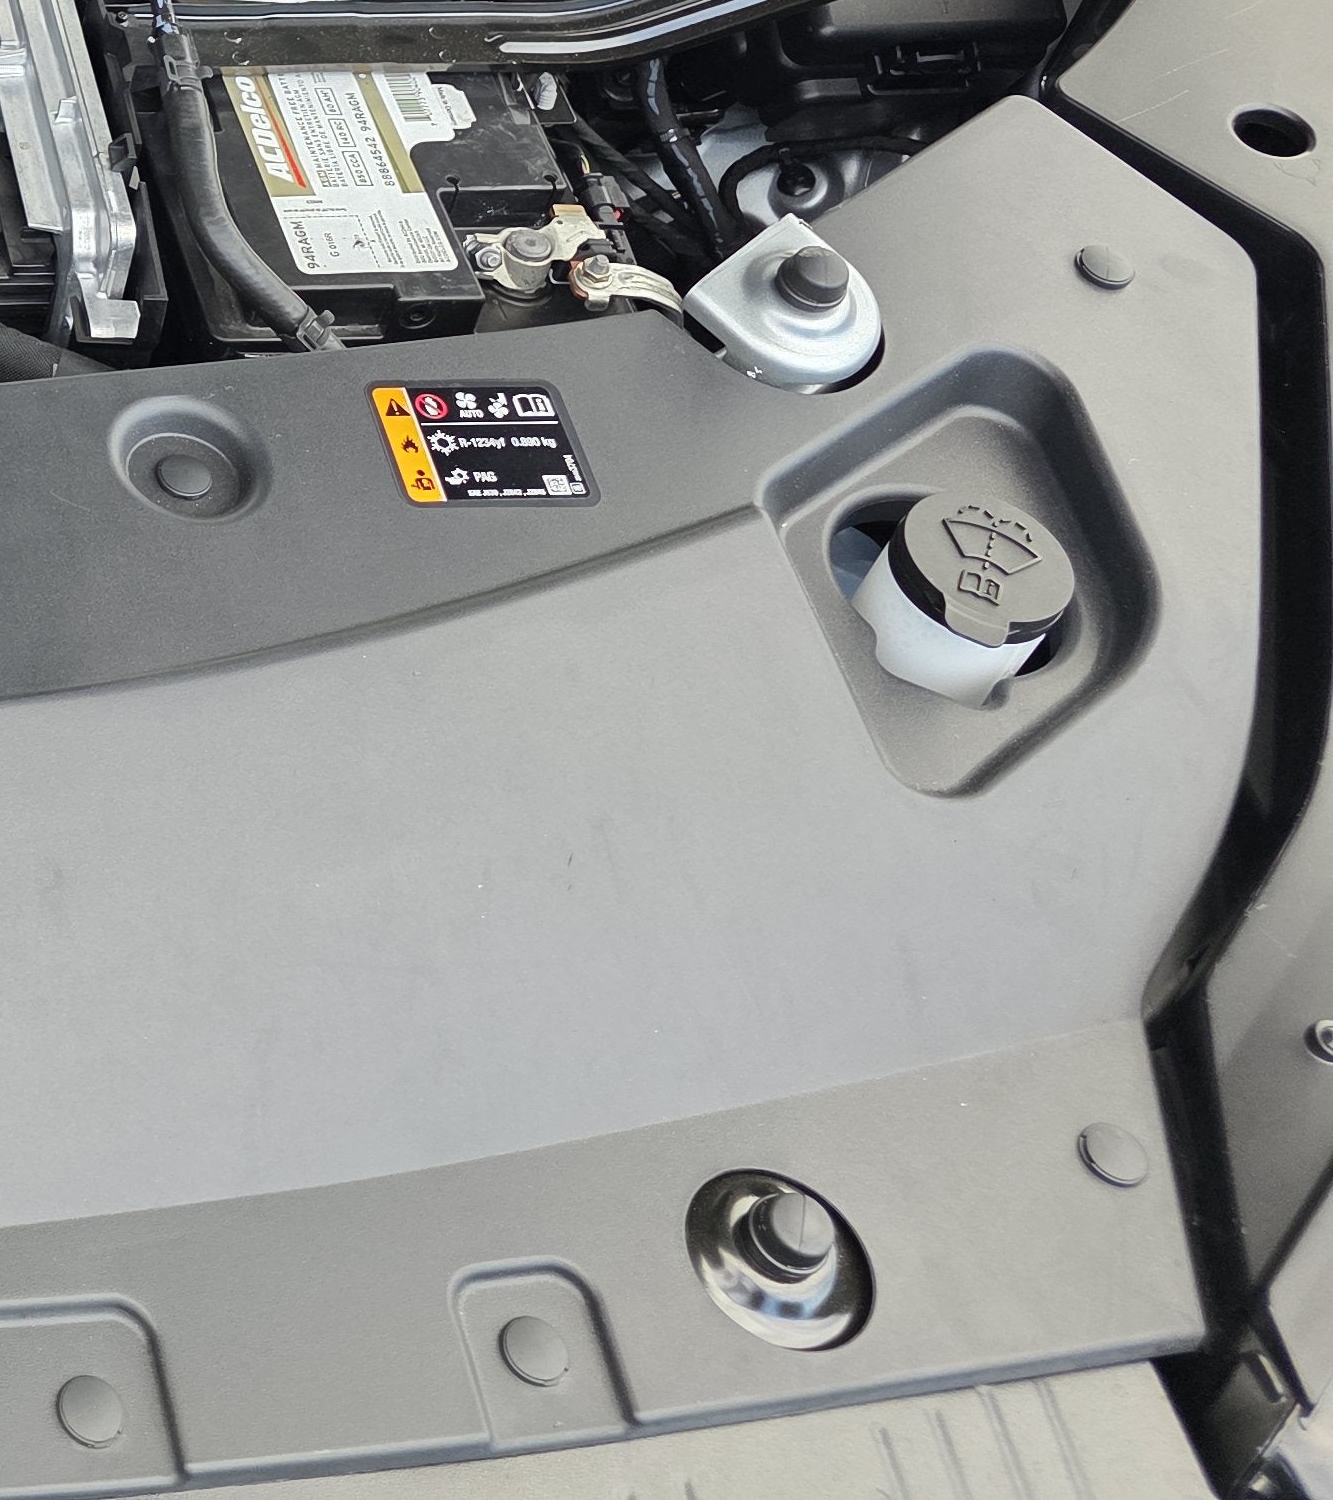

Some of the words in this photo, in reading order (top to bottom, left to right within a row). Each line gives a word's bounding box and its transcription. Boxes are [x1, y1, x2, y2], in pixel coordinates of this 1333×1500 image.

[286, 97, 300, 114] FREE
[344, 92, 371, 130] 94RAGM
[227, 76, 295, 183] ACDelco
[333, 120, 344, 130] RC
[294, 117, 322, 168] MAINTENANCE
[339, 132, 350, 143] 140
[348, 153, 360, 167] CCA
[363, 136, 395, 186] 88864542
[289, 220, 321, 268] 94RAGM
[321, 232, 337, 248] 016R
[460, 409, 484, 418] AUTO
[458, 437, 505, 449] R-1234yf
[541, 437, 557, 449] kg
[474, 472, 497, 482] PAG
